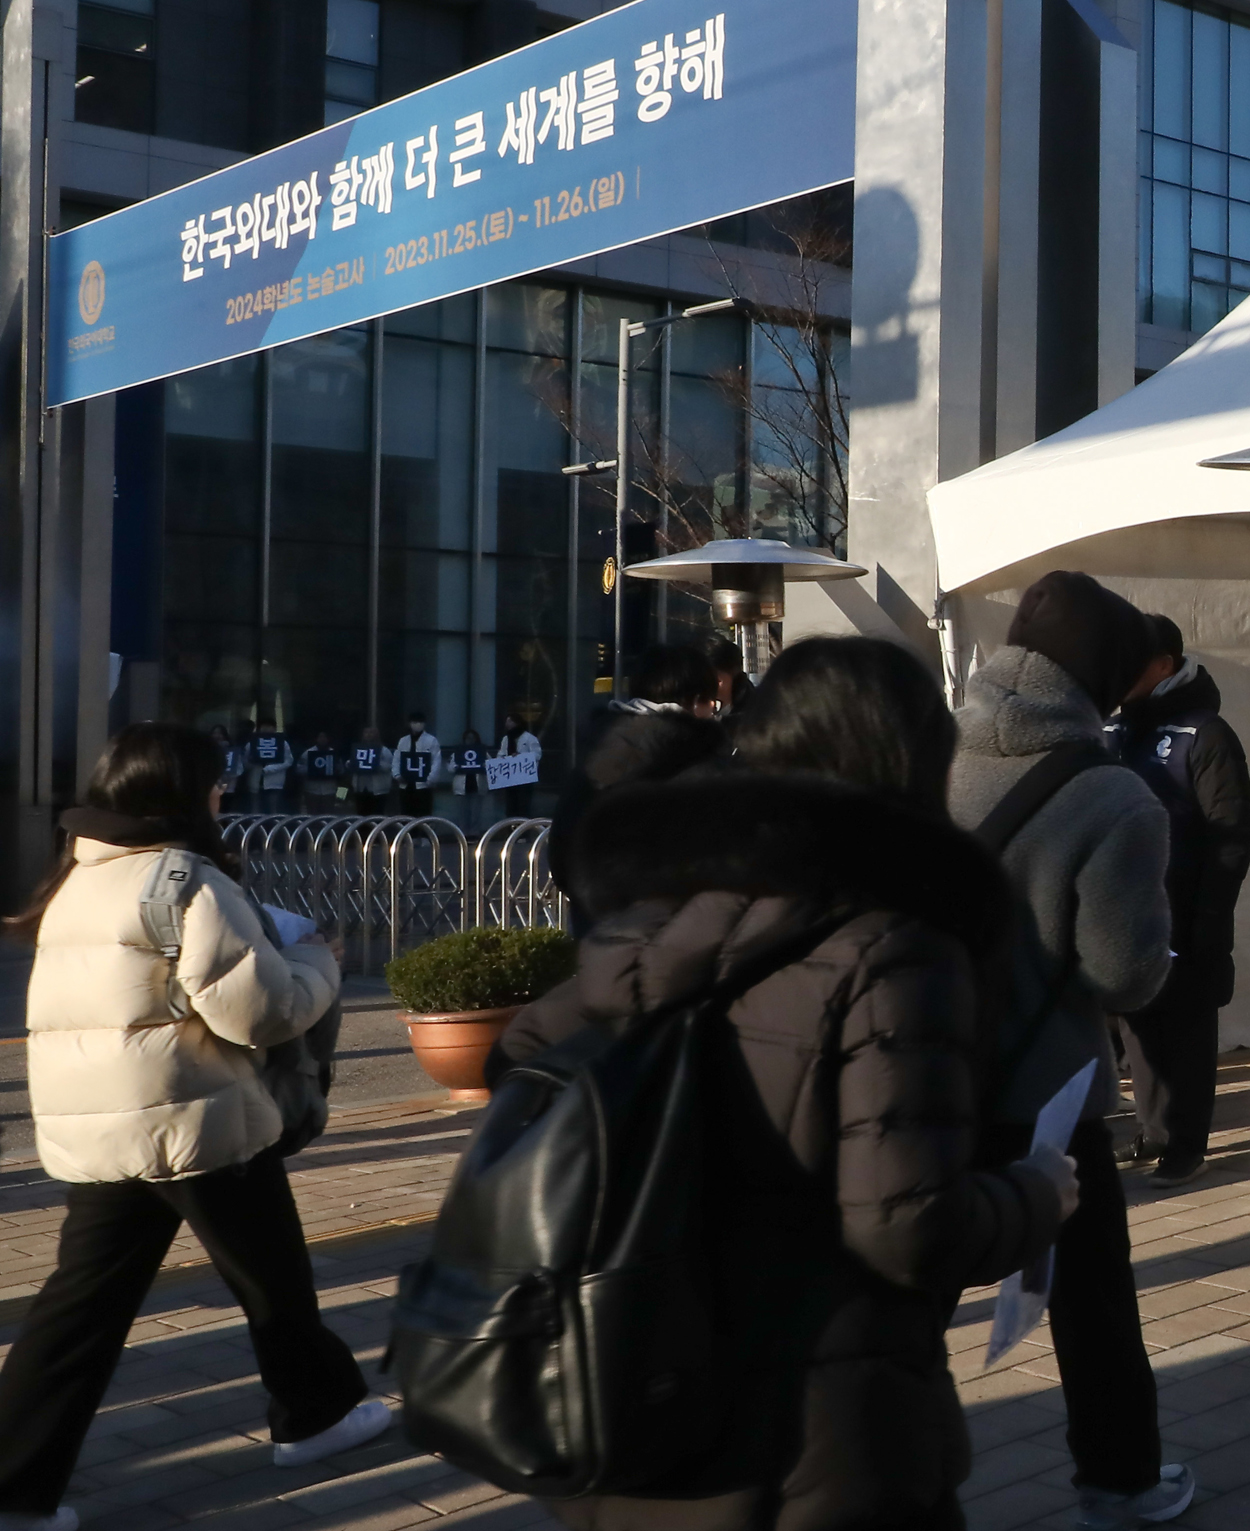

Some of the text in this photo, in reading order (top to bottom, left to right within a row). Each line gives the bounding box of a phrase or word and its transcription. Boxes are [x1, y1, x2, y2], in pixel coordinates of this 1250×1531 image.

[180, 13, 725, 282] 한국외대와 함께 더 큰 세계를 향해
[225, 276, 303, 325] 2024학년도
[307, 256, 365, 300] 논술고사
[384, 207, 513, 275] 2023.11.25.(토)
[533, 171, 625, 228] 11.26.(일)
[256, 737, 278, 759] 봄
[356, 748, 376, 769] 만
[461, 750, 481, 768] 요
[314, 754, 334, 776] 에
[407, 757, 426, 778] 나
[487, 758, 537, 784] 합격기원
